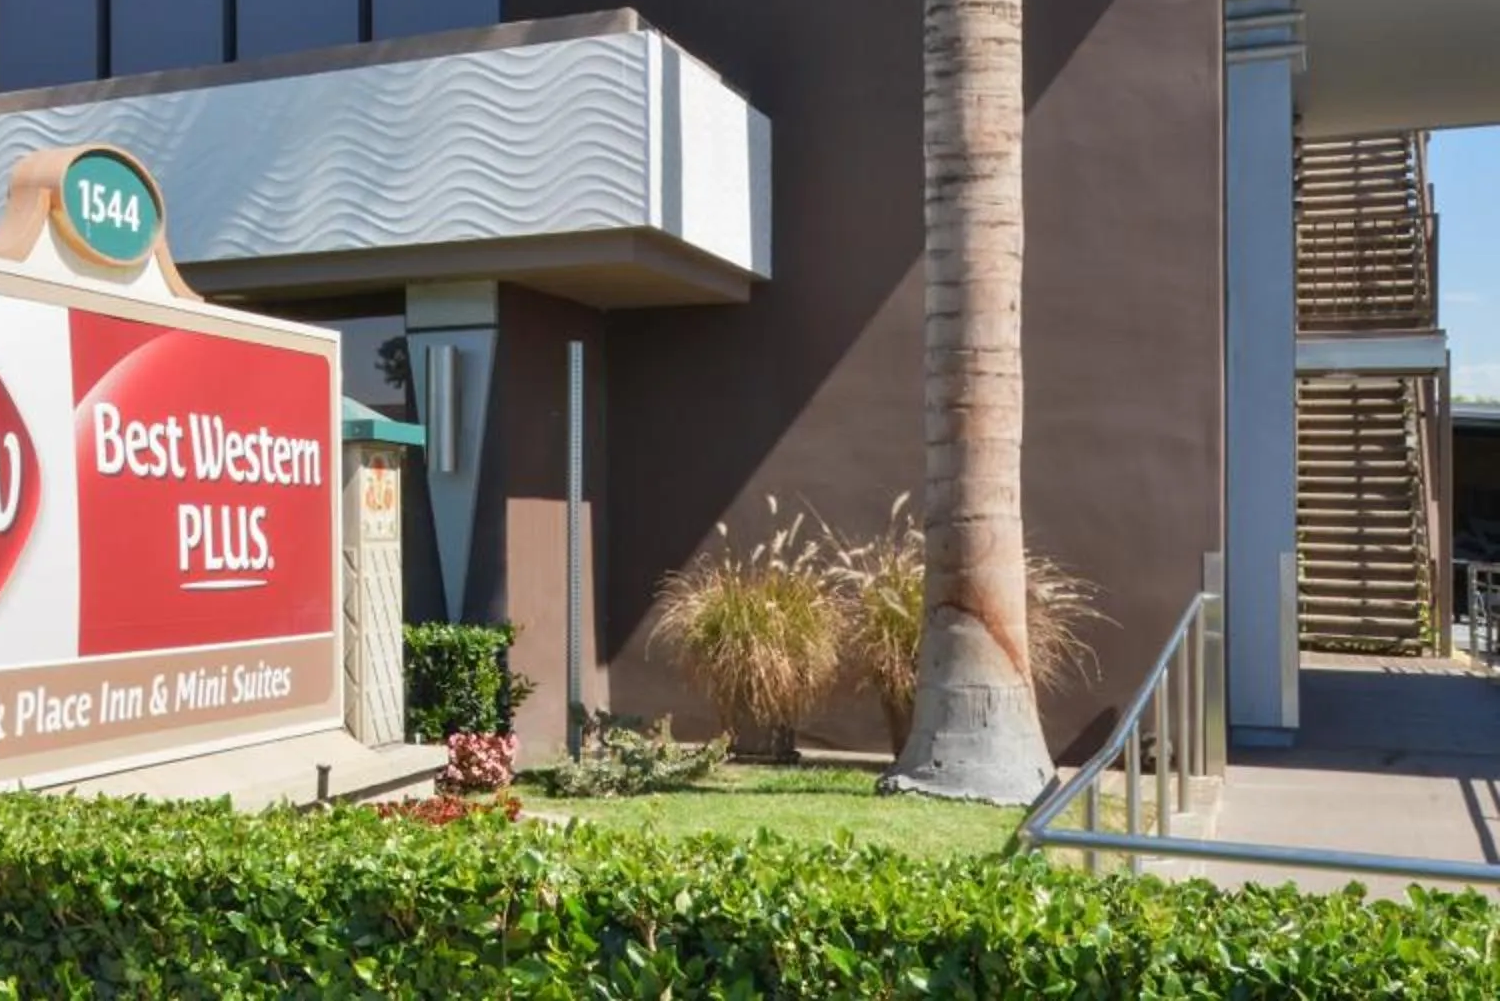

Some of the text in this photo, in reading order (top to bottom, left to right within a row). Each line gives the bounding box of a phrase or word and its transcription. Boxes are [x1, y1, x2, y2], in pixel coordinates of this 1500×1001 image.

[78, 179, 141, 232] 1544
[93, 402, 321, 486] Best Western
[15, 686, 93, 738] Place
[100, 680, 144, 724] Inn
[149, 673, 168, 716] &
[175, 665, 228, 712] Mini
[232, 659, 293, 705] Suites
